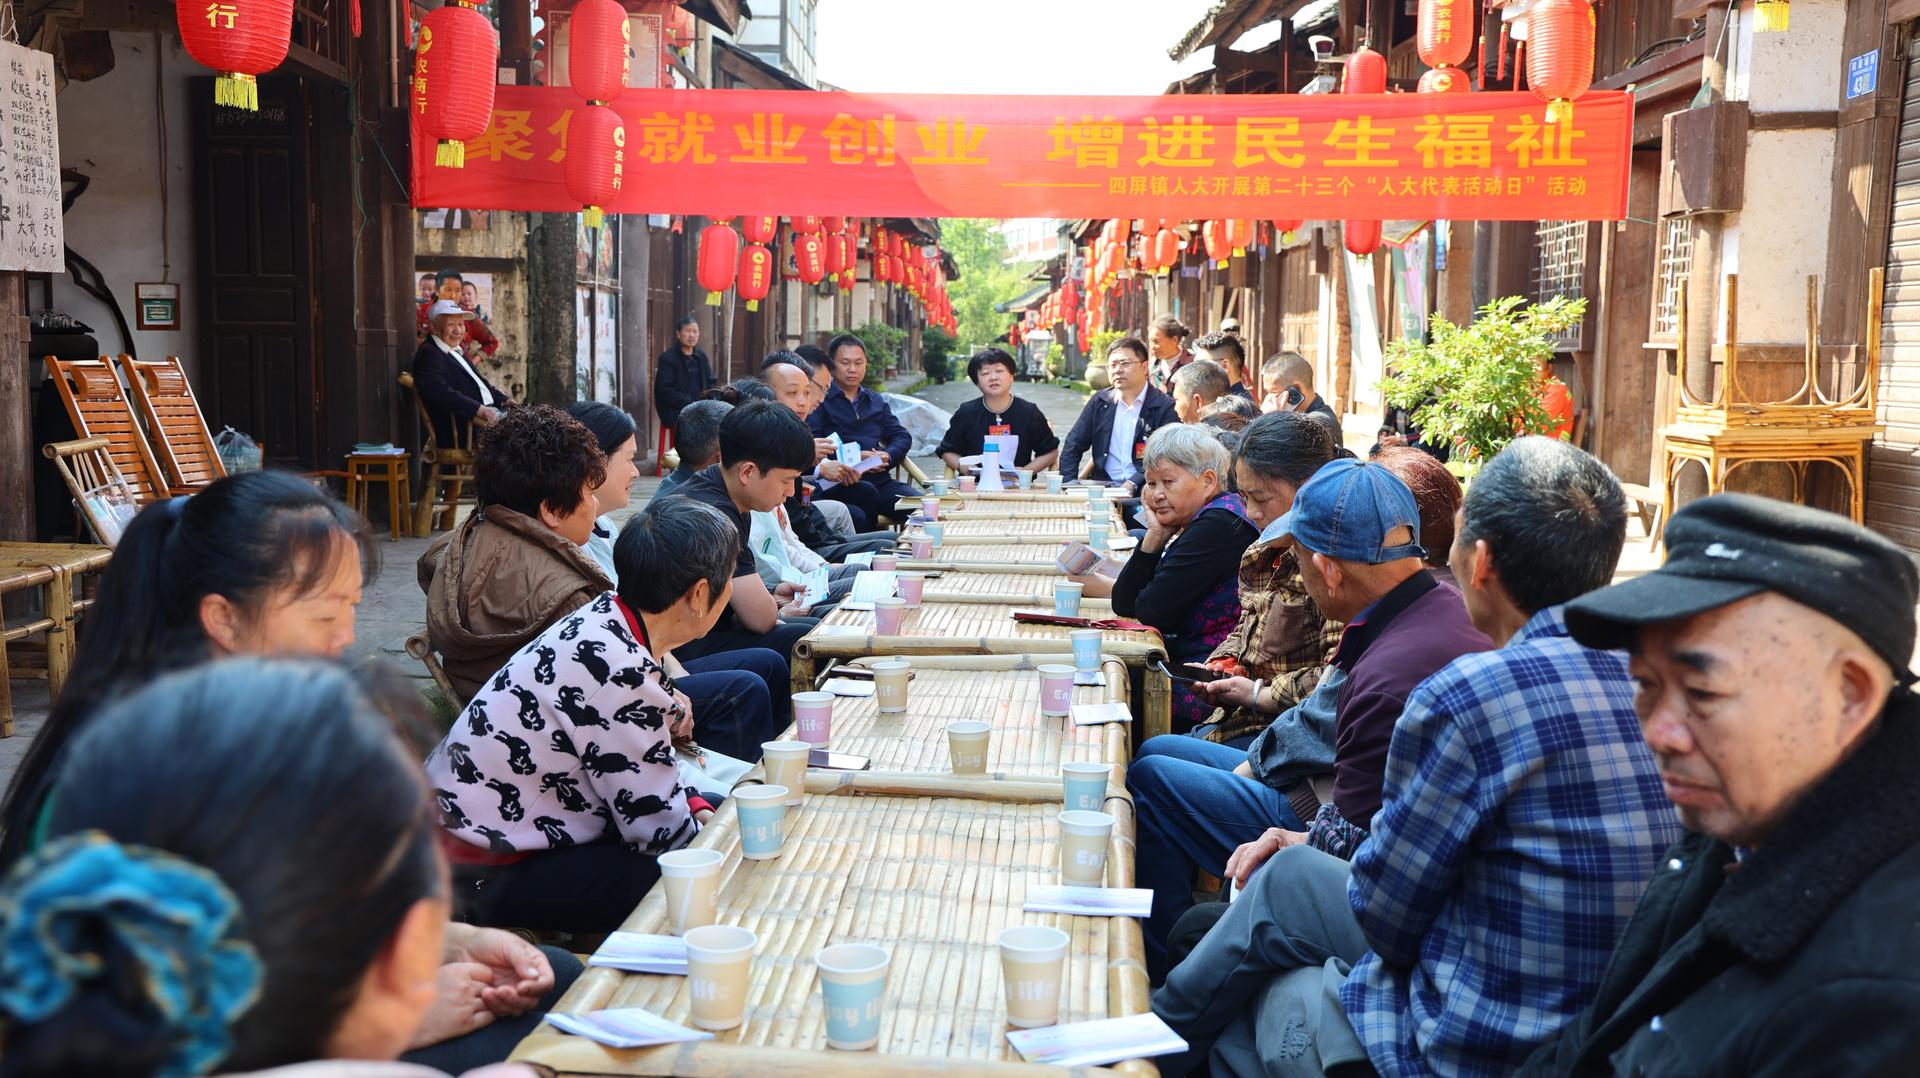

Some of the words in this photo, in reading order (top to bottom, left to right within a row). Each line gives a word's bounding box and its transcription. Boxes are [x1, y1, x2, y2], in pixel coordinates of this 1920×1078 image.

[206, 3, 239, 28] 行
[1045, 114, 1588, 169] 增进民生福祉
[1054, 688, 1072, 704] Enj
